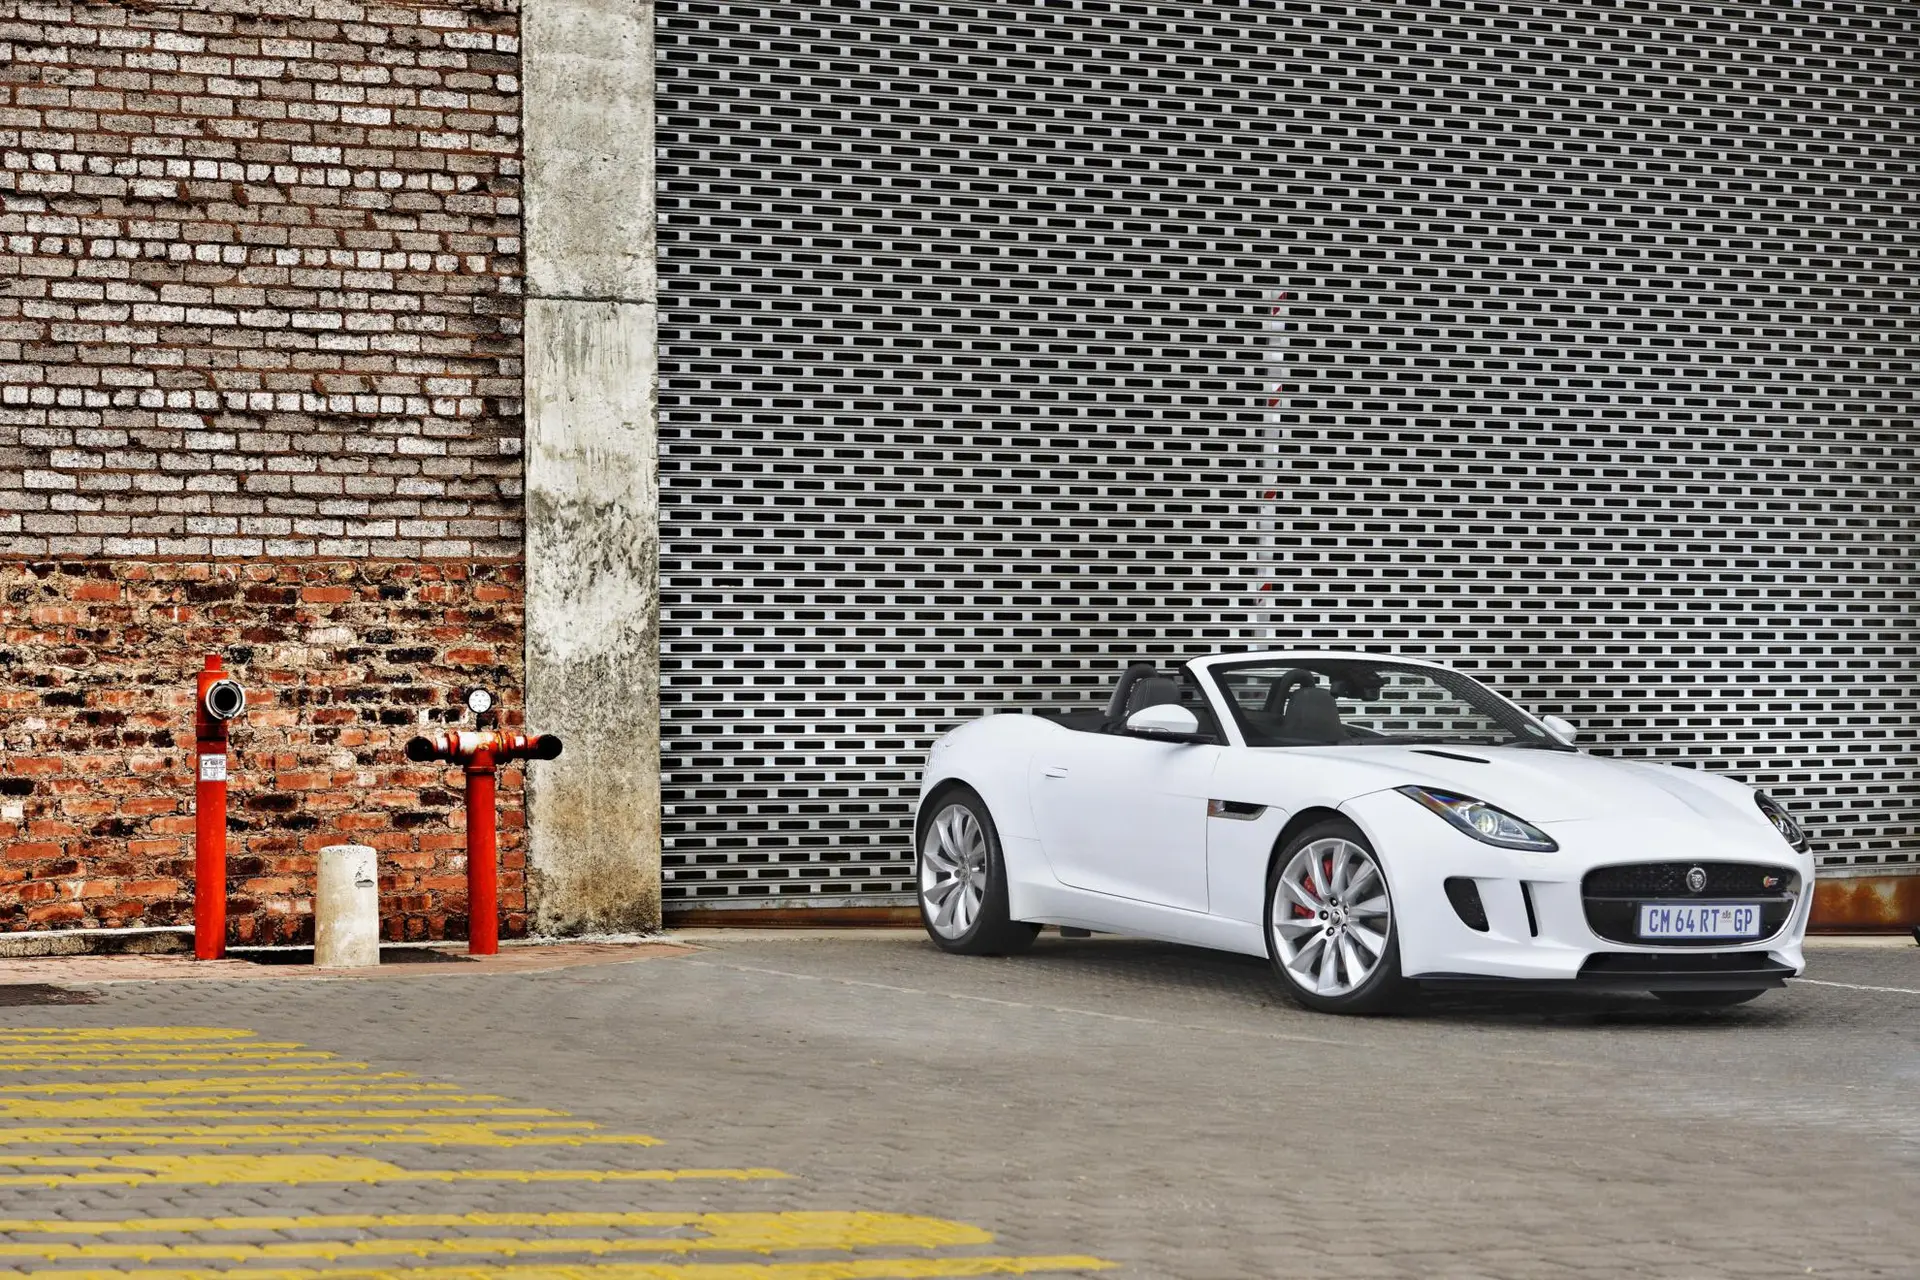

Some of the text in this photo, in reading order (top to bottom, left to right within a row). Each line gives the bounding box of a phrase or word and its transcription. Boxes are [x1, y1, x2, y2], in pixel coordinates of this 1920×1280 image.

[1649, 909, 1752, 932] CM 64 RT GP
